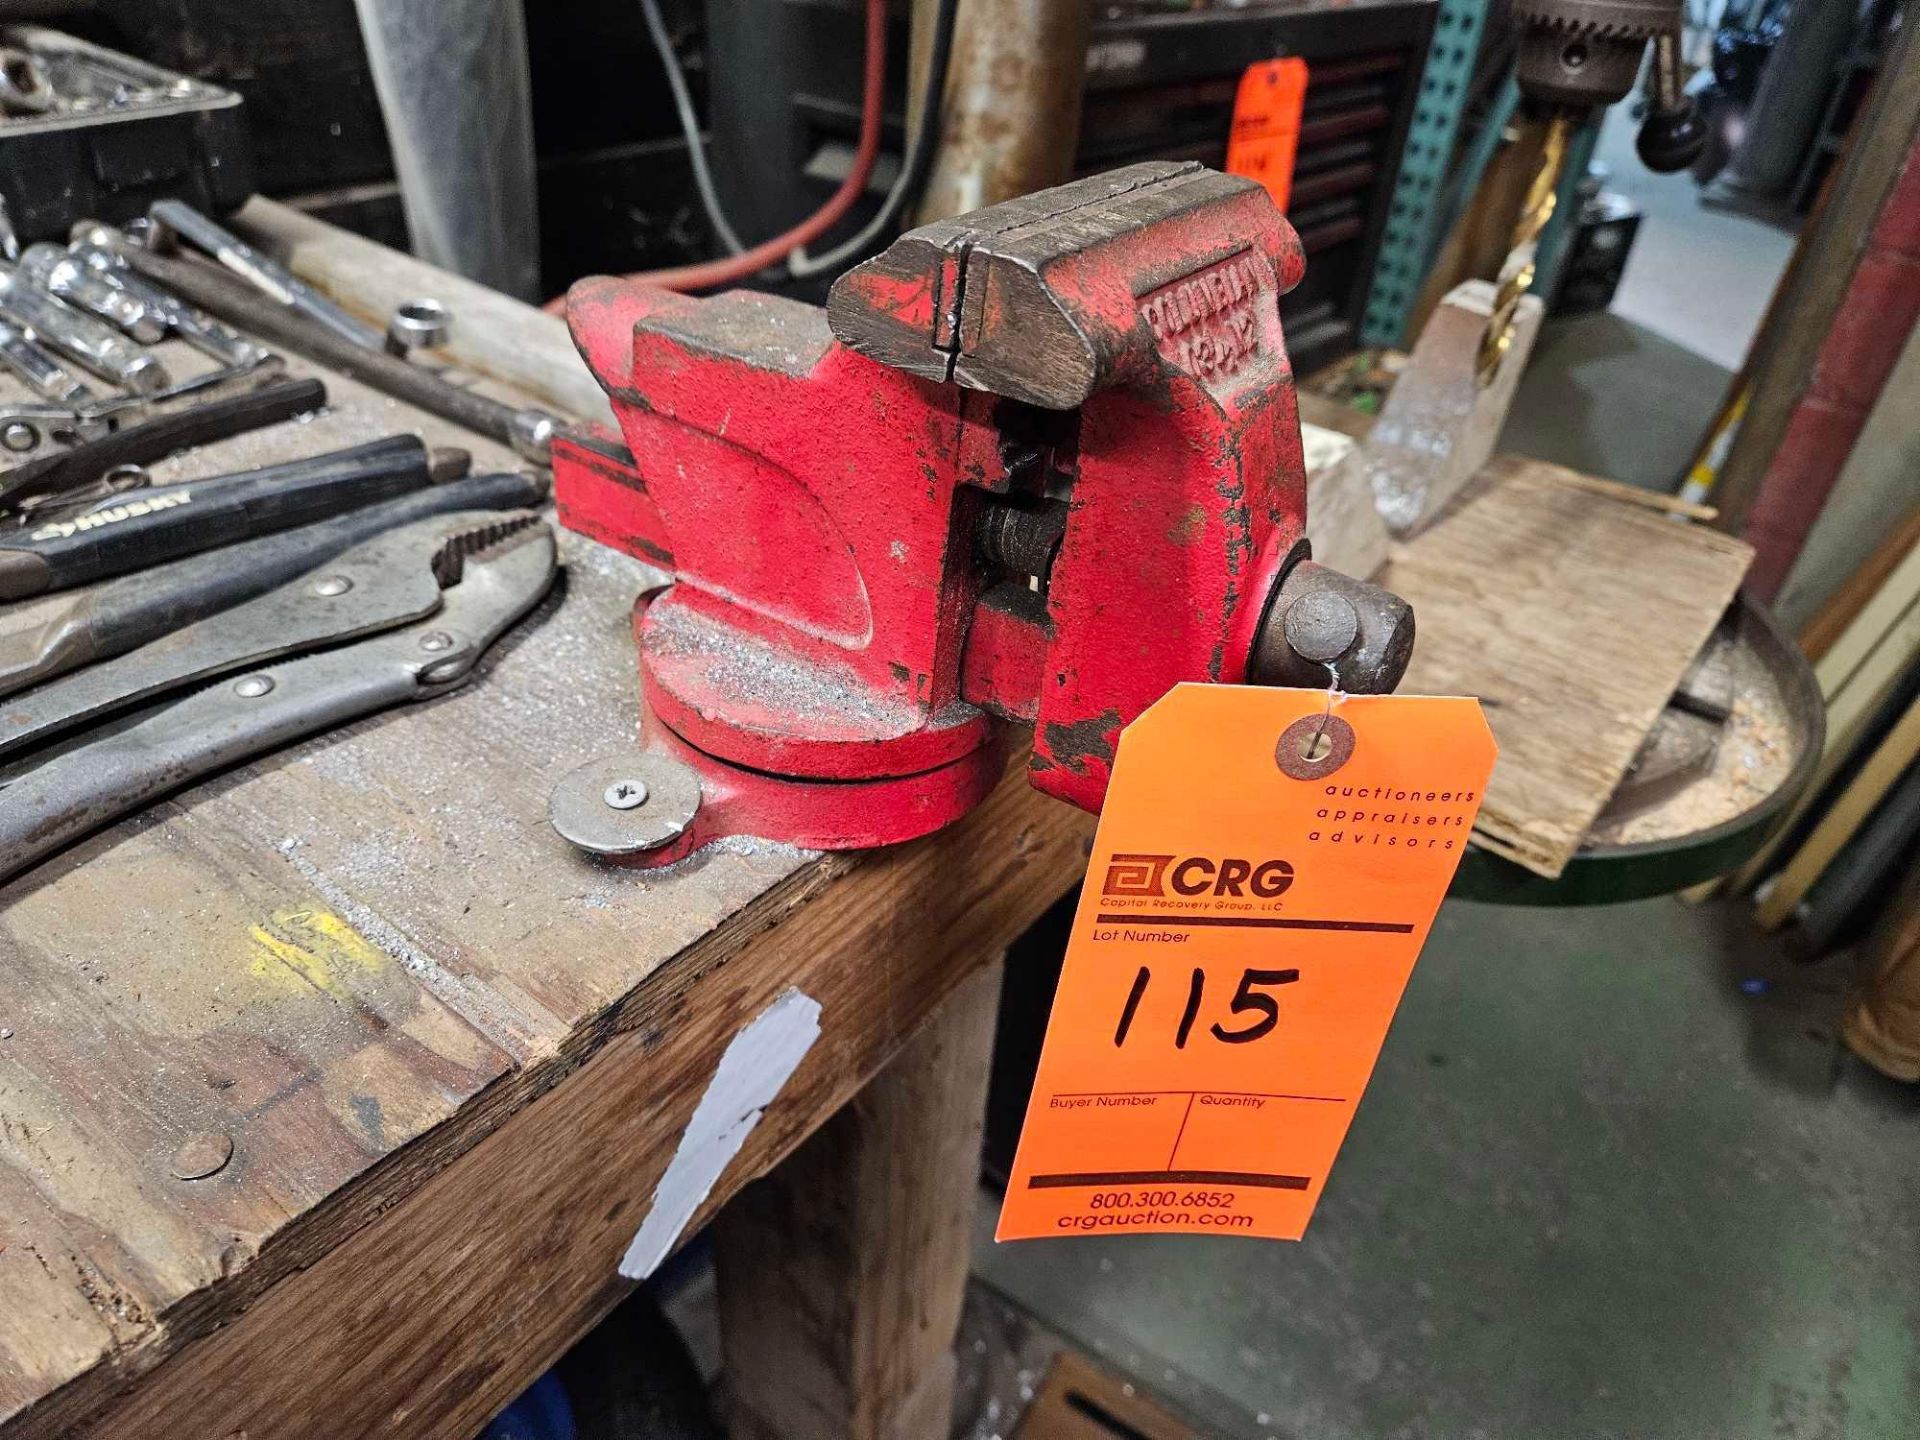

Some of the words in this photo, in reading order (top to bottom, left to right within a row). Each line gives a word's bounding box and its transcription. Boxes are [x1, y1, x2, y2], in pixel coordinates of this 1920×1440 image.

[75, 491, 191, 531] HUSKY
[1325, 785, 1475, 802] auctioneers
[1316, 808, 1464, 826] appraisers
[1308, 831, 1454, 850] advisors
[1171, 857, 1295, 899] CRG
[1100, 897, 1147, 909] Capital
[1152, 899, 1210, 911] Recovery
[1092, 929, 1120, 942] Lot
[1123, 930, 1191, 944] Number
[1114, 966, 1300, 1049] 115
[1050, 1097, 1092, 1109] Buyer
[1096, 1095, 1158, 1107] Number
[1200, 1095, 1266, 1109] Quantity
[1090, 1191, 1236, 1210] 800.300.6852
[1057, 1211, 1254, 1230] crgauction.com
